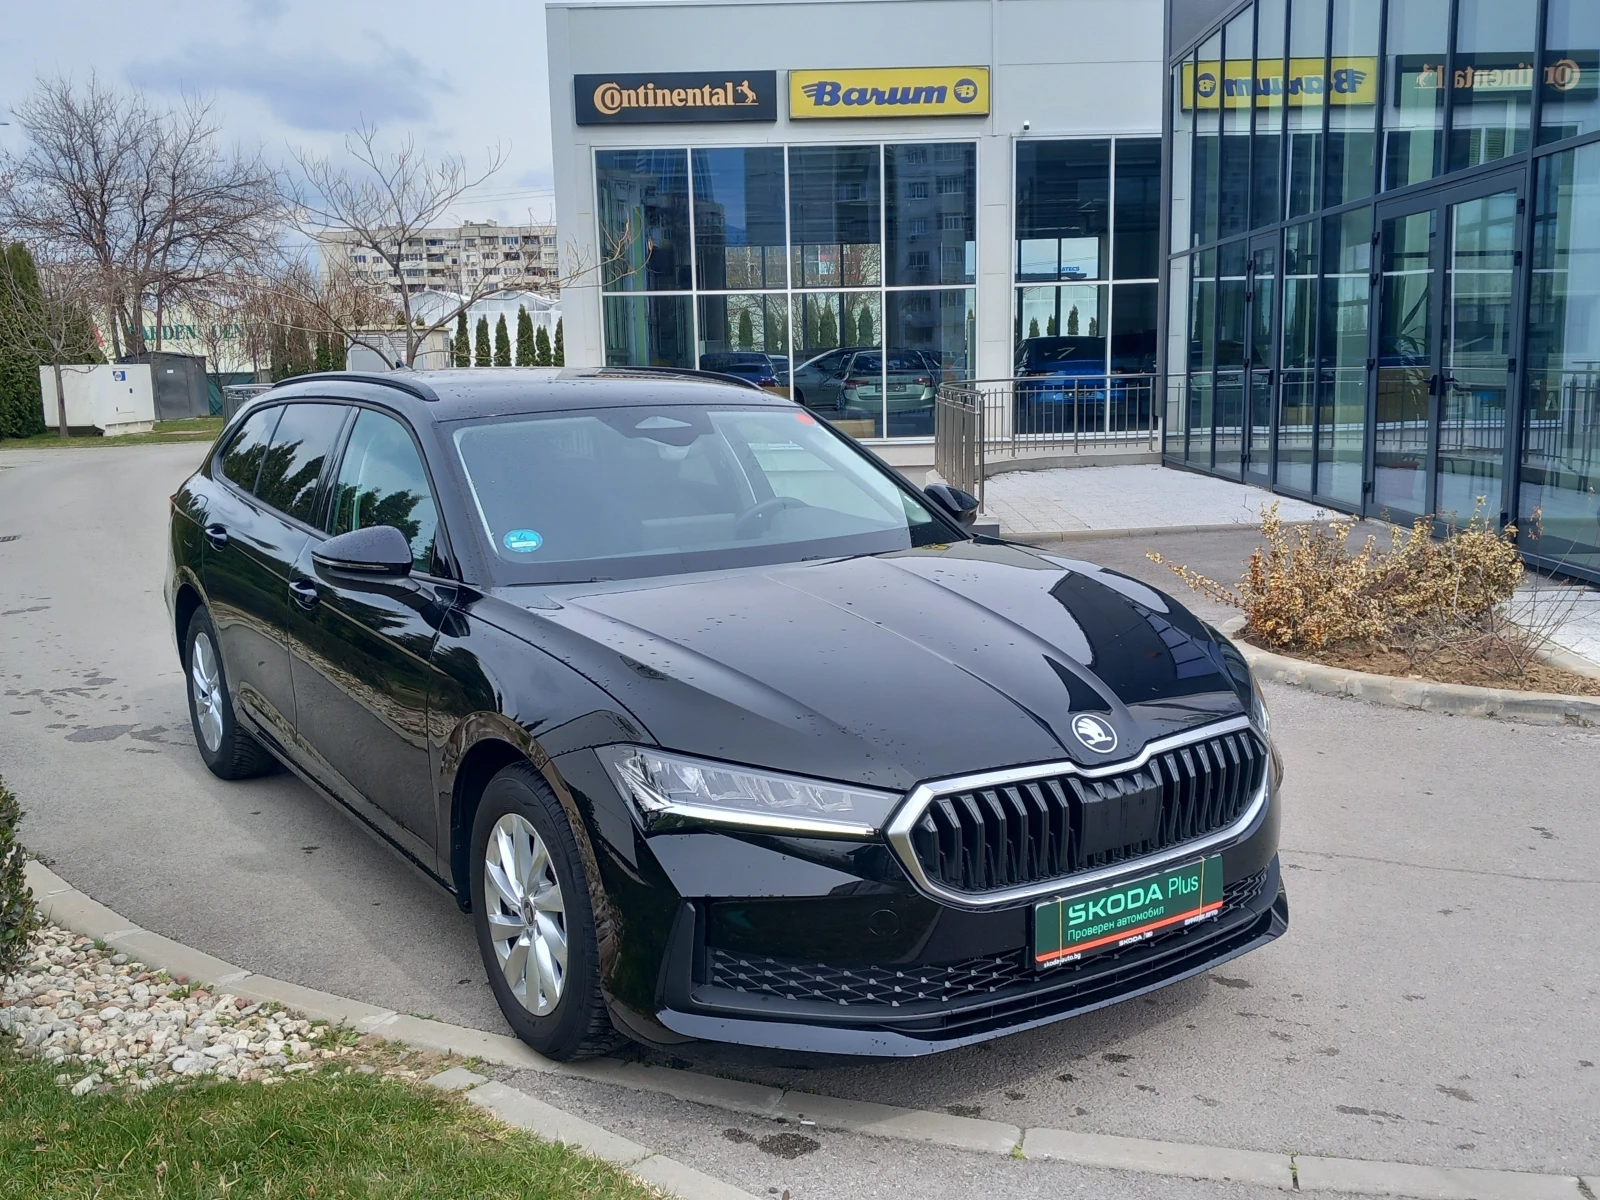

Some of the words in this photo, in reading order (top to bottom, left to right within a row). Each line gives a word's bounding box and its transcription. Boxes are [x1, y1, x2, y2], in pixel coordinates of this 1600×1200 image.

[594, 81, 735, 115] Continental
[806, 80, 946, 106] Barum
[1168, 875, 1199, 898] Plus
[1067, 921, 1115, 942] Проверен
[1116, 906, 1165, 928] автомобил
